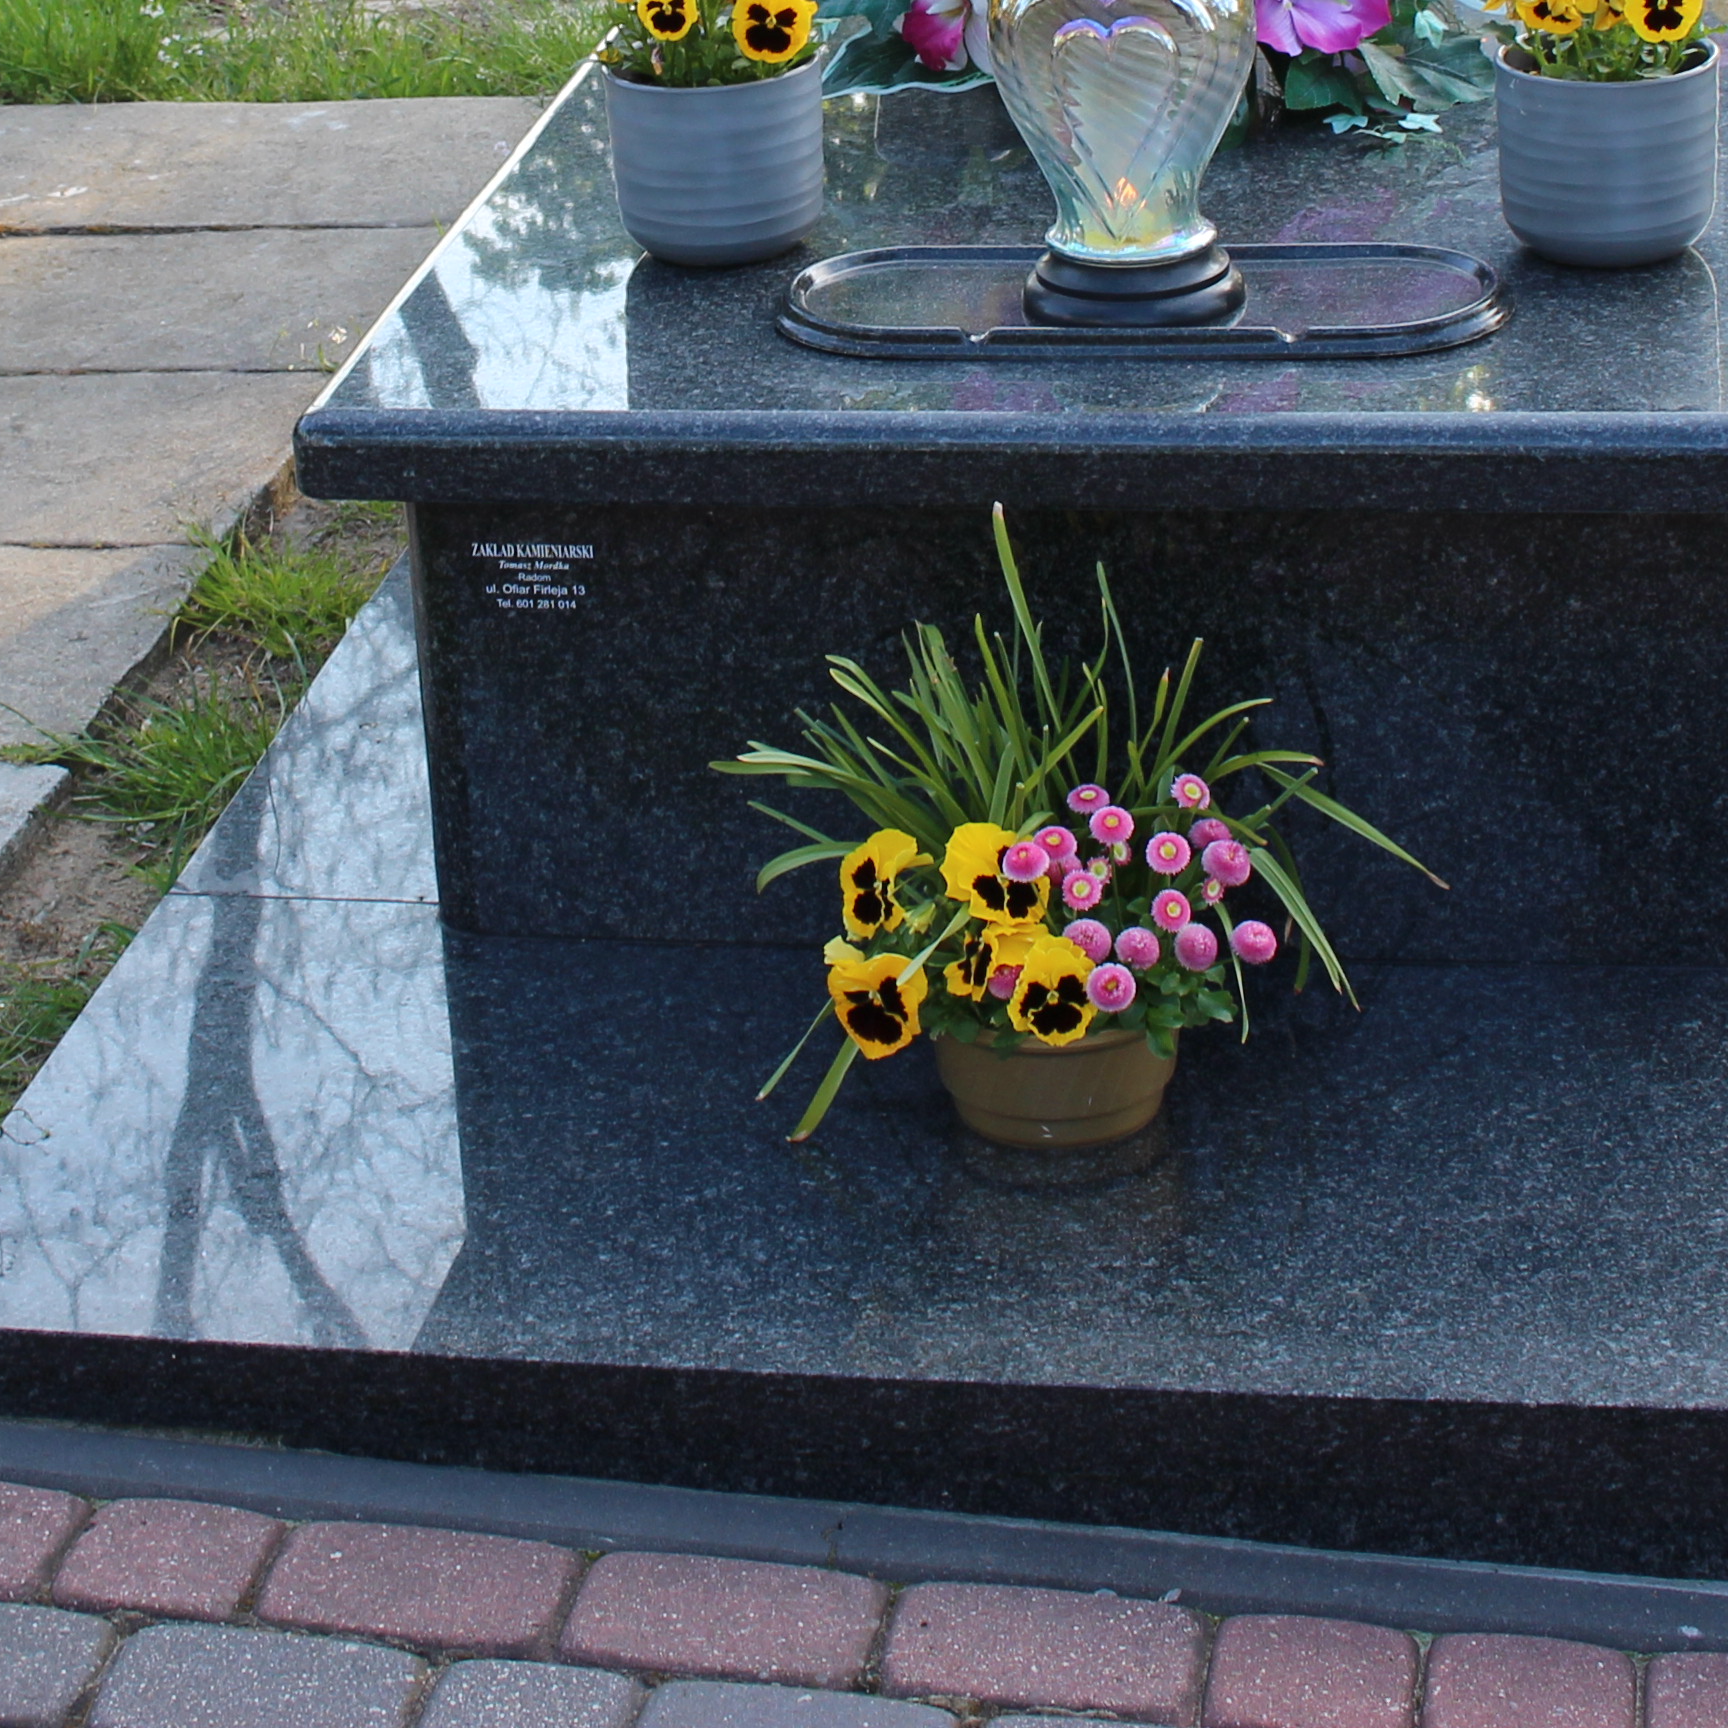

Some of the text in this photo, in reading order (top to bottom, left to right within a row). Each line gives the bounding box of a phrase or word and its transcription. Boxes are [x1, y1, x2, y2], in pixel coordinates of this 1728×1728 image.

[516, 543, 594, 559] KAMIENIARSKI
[498, 559, 532, 571] Tomasz
[517, 572, 552, 582] Radom
[485, 583, 586, 598] ul. Ofiar Firleja 13
[516, 599, 534, 609] 601
[537, 599, 555, 609] 281
[557, 600, 577, 610] 014
